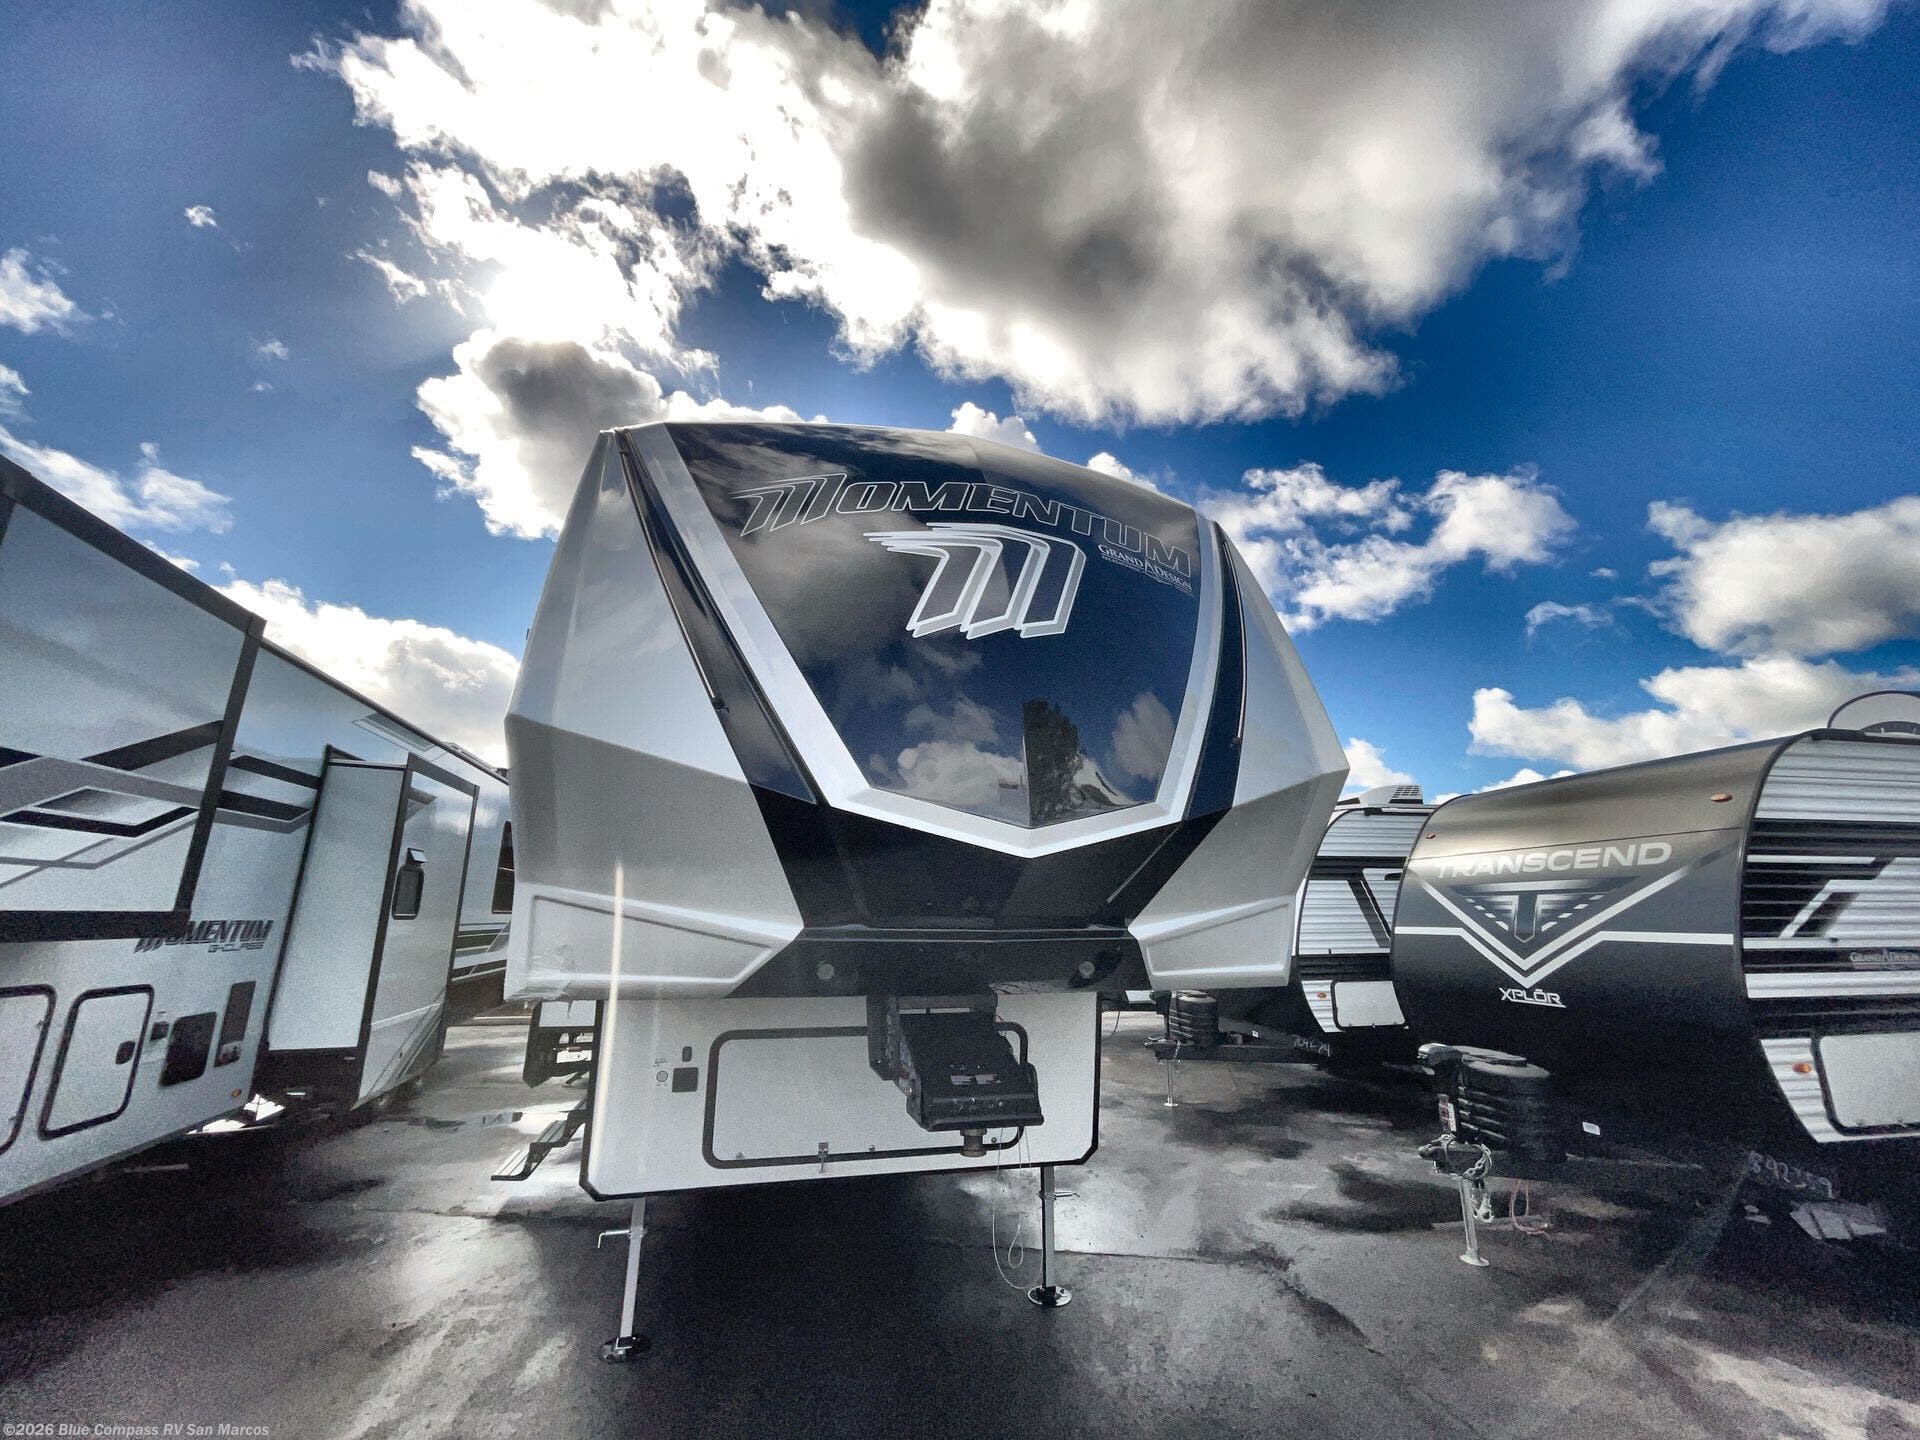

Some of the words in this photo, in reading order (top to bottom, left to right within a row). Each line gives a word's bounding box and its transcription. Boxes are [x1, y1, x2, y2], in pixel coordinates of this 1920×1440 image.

[728, 473, 1192, 578] MOMENTUM
[1098, 544, 1144, 567] GRAND
[1153, 565, 1193, 592] DESIGN
[1434, 842, 1673, 878] TRANSCEND
